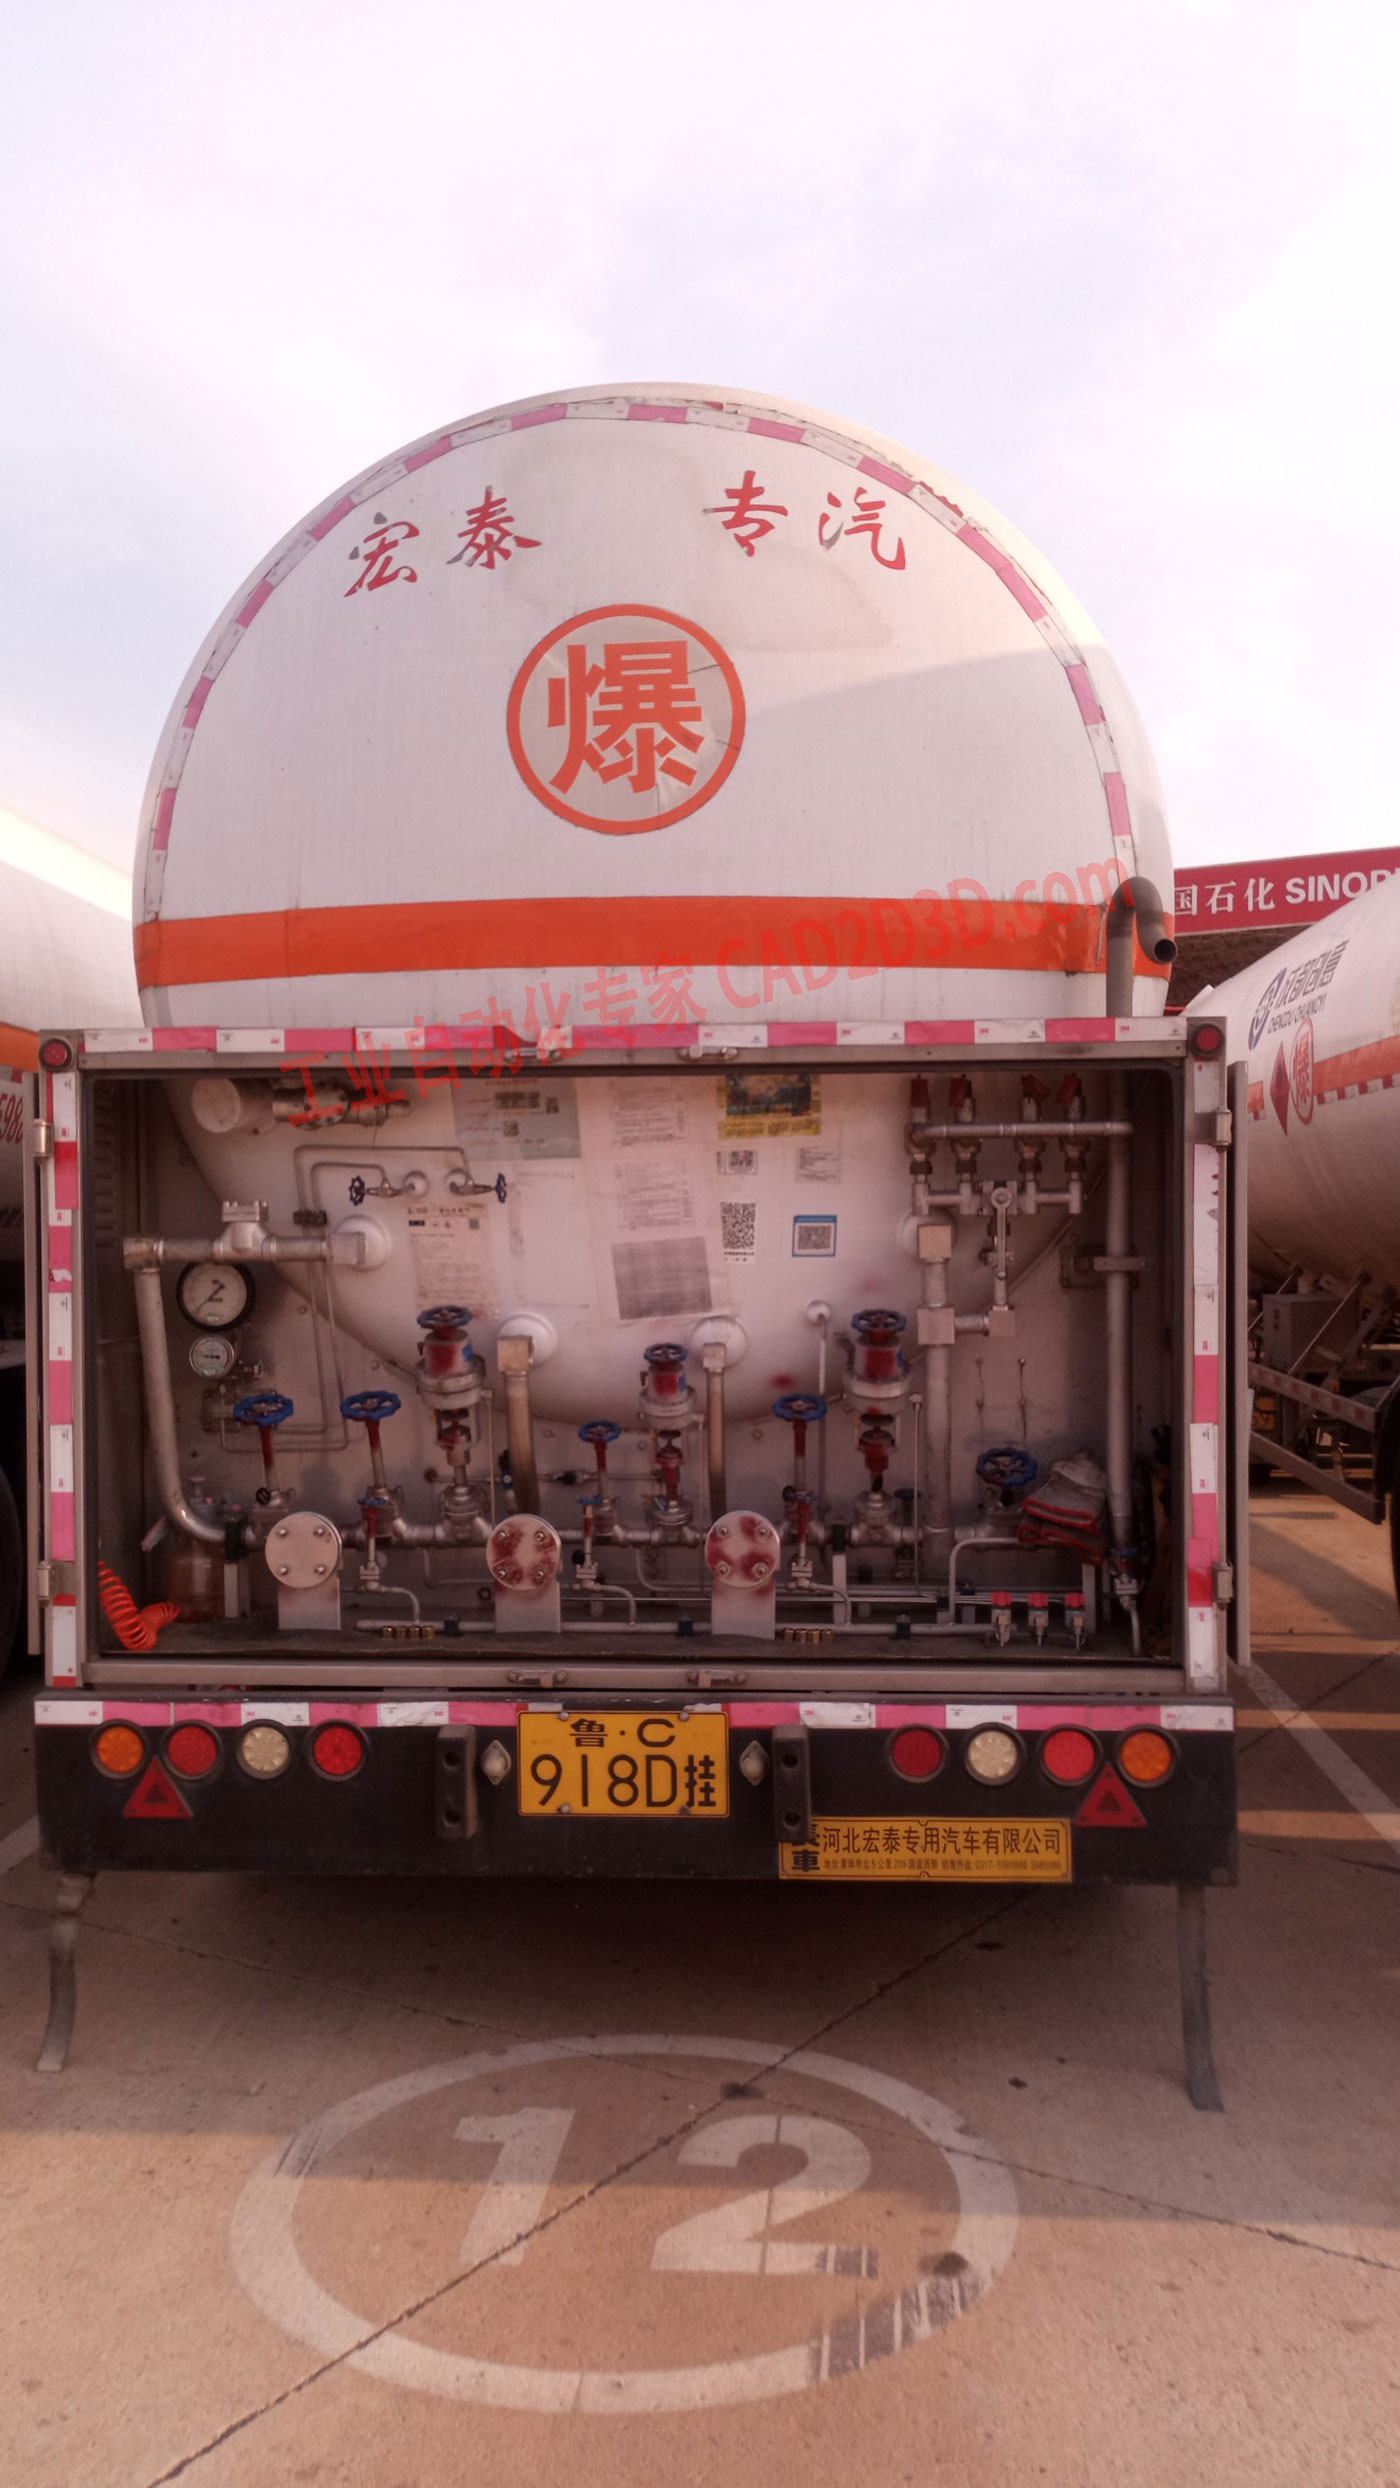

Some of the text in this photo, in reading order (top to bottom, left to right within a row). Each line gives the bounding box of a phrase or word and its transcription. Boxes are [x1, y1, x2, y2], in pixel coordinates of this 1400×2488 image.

[547, 640, 705, 795] 爆
[531, 1754, 716, 1808] 918D挂
[823, 1827, 1060, 1855] 河北宏泰专用汽车有限公司
[453, 2107, 879, 2278] 12
